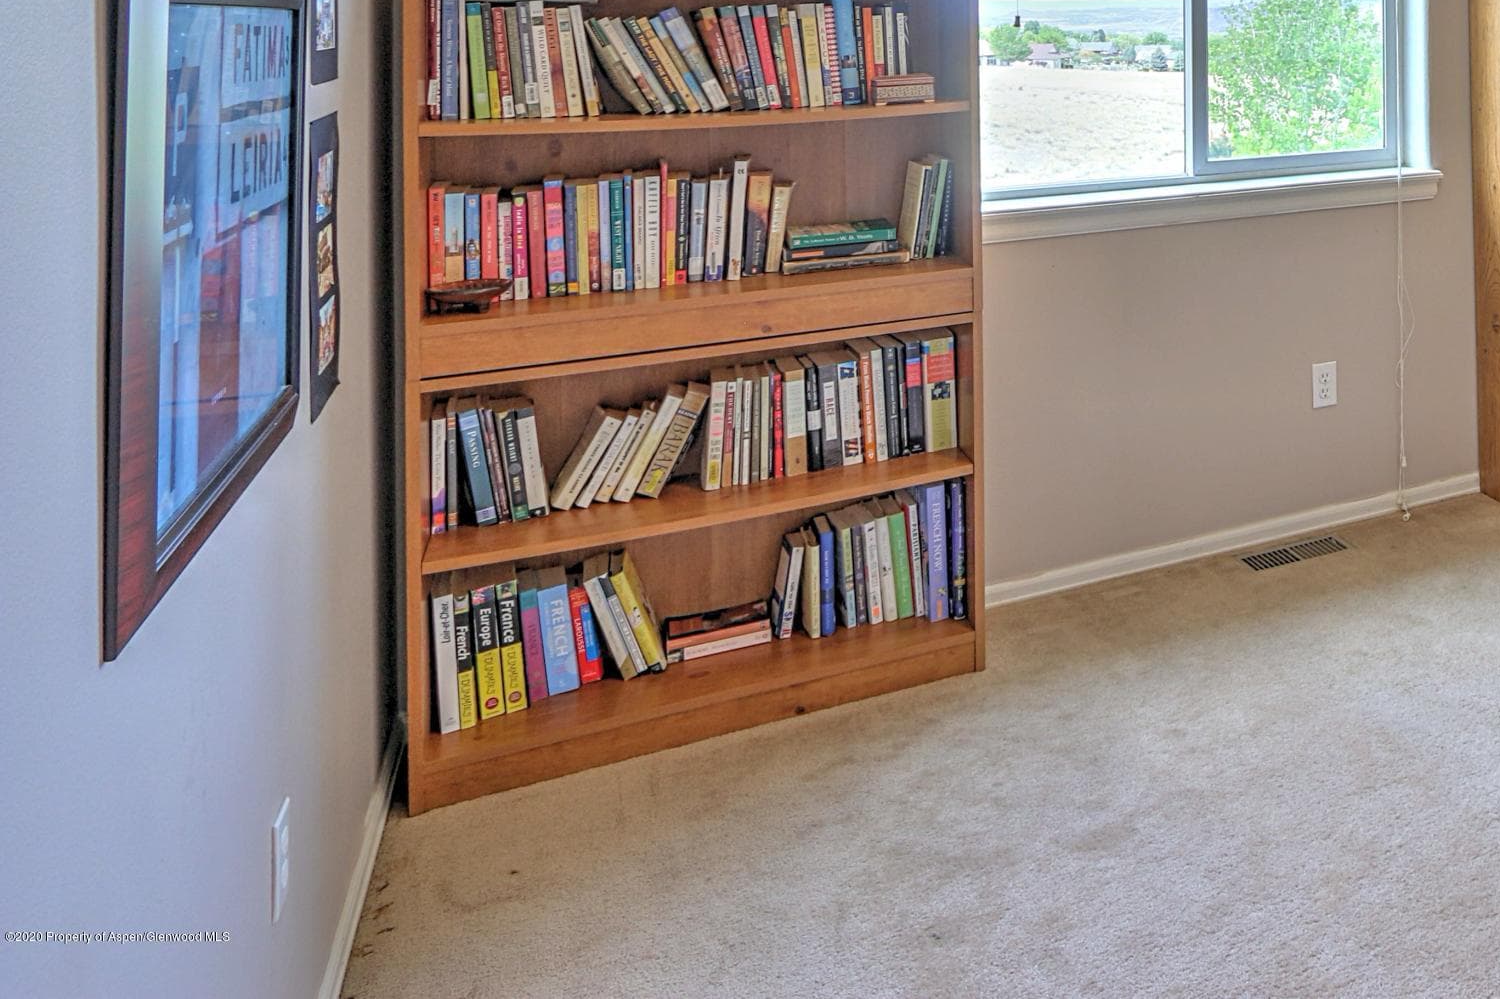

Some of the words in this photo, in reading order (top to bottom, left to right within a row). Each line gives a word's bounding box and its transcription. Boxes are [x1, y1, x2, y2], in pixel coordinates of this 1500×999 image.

[233, 23, 286, 84] FATIMA
[536, 29, 545, 49] WILD
[541, 71, 550, 93] QUILT
[230, 128, 282, 204] LEIRIA
[515, 209, 523, 225] India
[862, 375, 870, 388] Black
[824, 397, 835, 416] RACE
[864, 410, 872, 424] Black
[466, 430, 480, 468] PASSING
[928, 502, 945, 542] FRENCH
[931, 543, 945, 571] NOW!
[475, 607, 496, 646] Europe
[498, 599, 519, 643] France
[548, 599, 570, 656] FRENCH
[573, 618, 585, 653] LAROUSSE
[453, 625, 472, 660] French
[481, 657, 497, 695] DUMMIES
[506, 652, 521, 688] DUMMIES
[458, 678, 474, 717] DUMMIES
